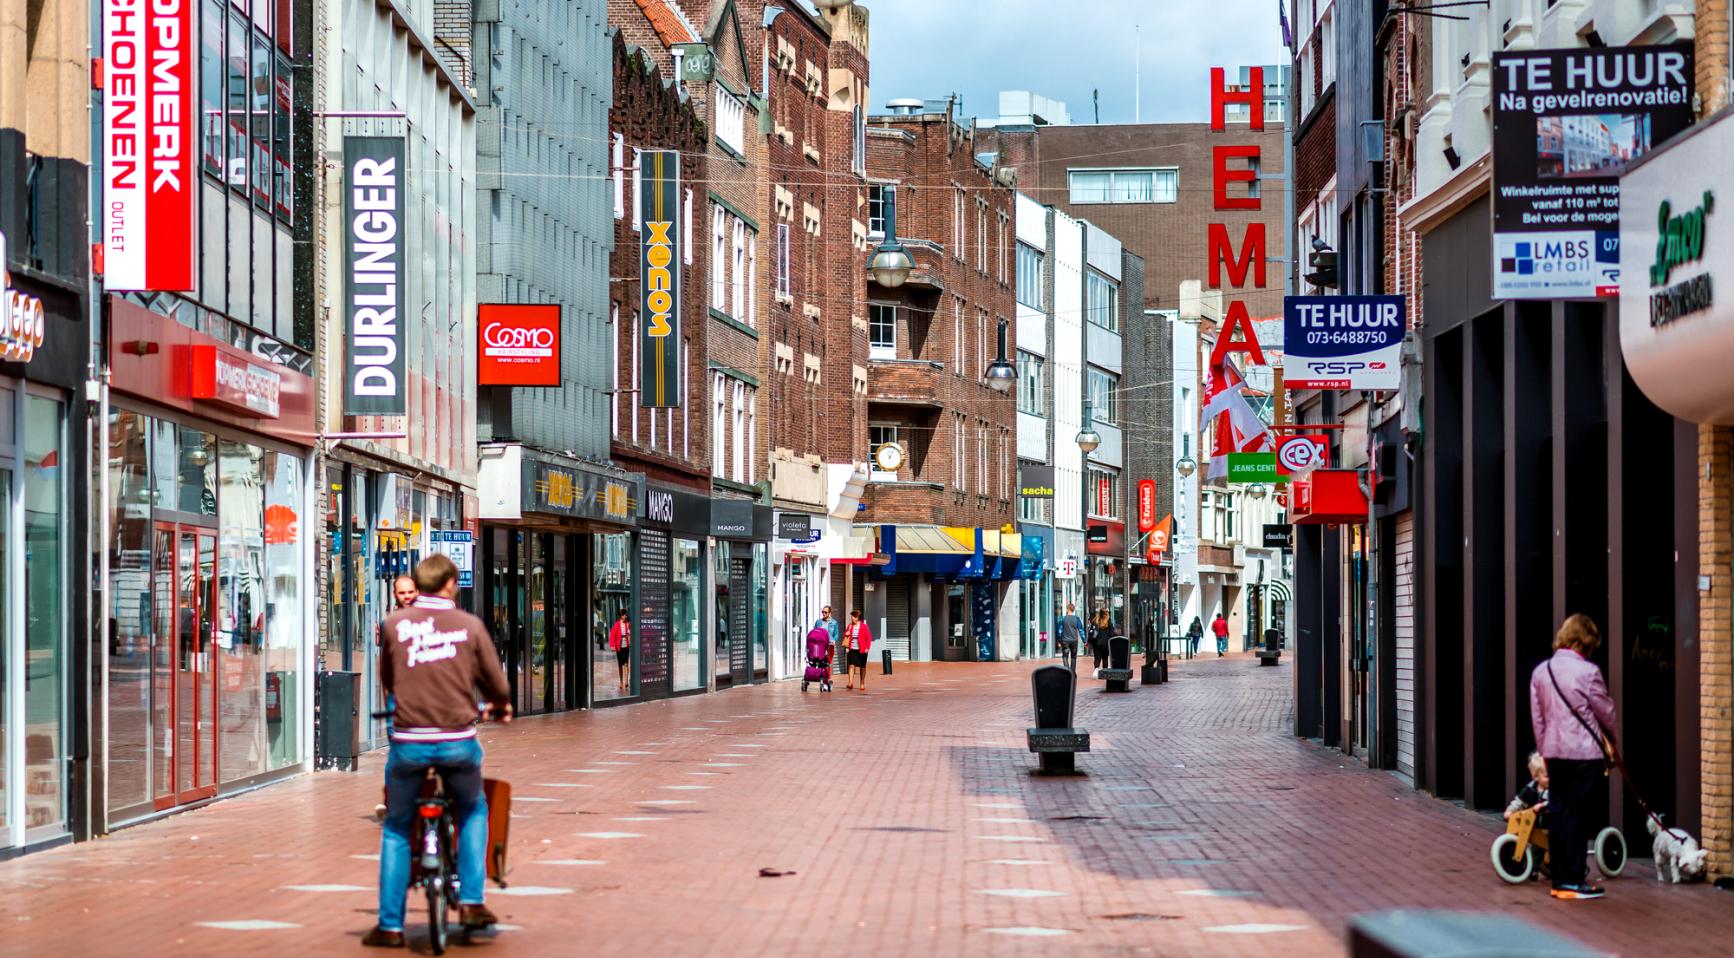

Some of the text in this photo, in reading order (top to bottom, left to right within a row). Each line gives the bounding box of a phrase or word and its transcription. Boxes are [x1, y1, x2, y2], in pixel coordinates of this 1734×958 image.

[1500, 52, 1687, 92] TE HUUR
[1500, 86, 1688, 114] Na gevelrenovatie!
[1501, 185, 1573, 197] Winkelruimte
[1575, 184, 1597, 194] met
[1532, 199, 1563, 209] vanaf
[1566, 198, 1585, 208] 110
[1604, 198, 1619, 207] tot
[1208, 67, 1266, 366] HEMA
[1523, 213, 1541, 223] Bel
[1544, 213, 1569, 222] voor
[1571, 211, 1586, 221] de
[112, 201, 124, 252] OUTLET
[1535, 241, 1588, 259] LMBS
[1534, 259, 1590, 273] retail
[353, 157, 397, 396] DURLINGER
[1295, 303, 1399, 327] TE HUUR
[1308, 362, 1366, 375] RSP
[1307, 380, 1349, 388] www.rsp.nl
[1022, 486, 1054, 496] sacha
[648, 490, 674, 523] MANGO
[1142, 487, 1151, 517] Kruidvat
[444, 532, 472, 541] TE HUUR
[1063, 561, 1074, 575] T
